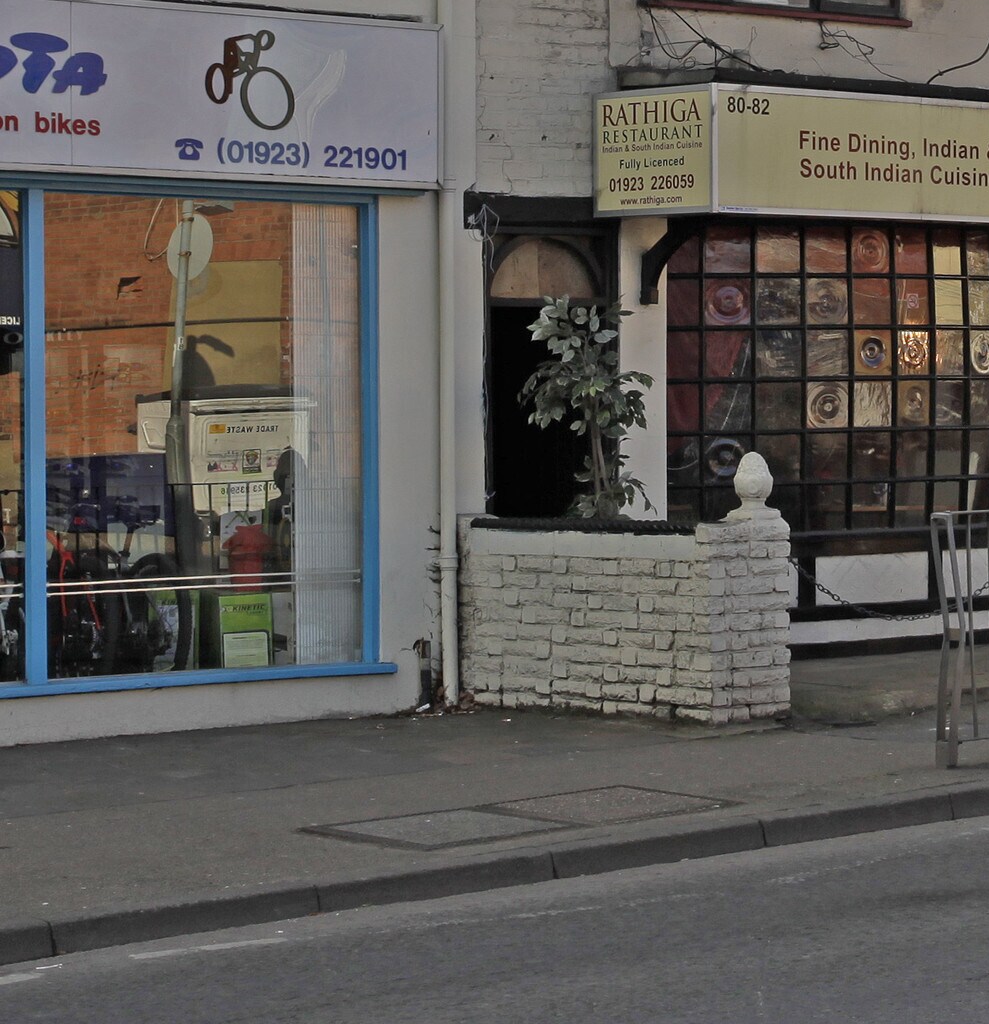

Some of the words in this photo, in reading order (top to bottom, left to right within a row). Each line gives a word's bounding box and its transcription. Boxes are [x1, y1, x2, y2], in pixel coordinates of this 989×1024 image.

[602, 98, 702, 127] RATHIGA
[727, 96, 770, 115] 80-82
[34, 111, 101, 136] bikes
[603, 124, 703, 144] RESTAURANT
[217, 137, 310, 168] (01923)
[324, 145, 408, 171] 221901
[602, 145, 622, 153] Indian
[631, 144, 651, 152] South
[653, 142, 674, 150] Indian
[676, 140, 703, 149] Cuisine
[799, 130, 841, 151] Fine
[848, 133, 916, 160] Dining,
[923, 138, 980, 159] Indian
[619, 159, 641, 171] Fully
[644, 156, 685, 168] Licenced
[800, 158, 857, 180] South
[865, 162, 923, 183] Indian
[609, 176, 644, 193] 01923
[650, 174, 695, 190] 226059
[620, 195, 683, 206] www.rathiga.com
[232, 604, 266, 612] KINETIC
